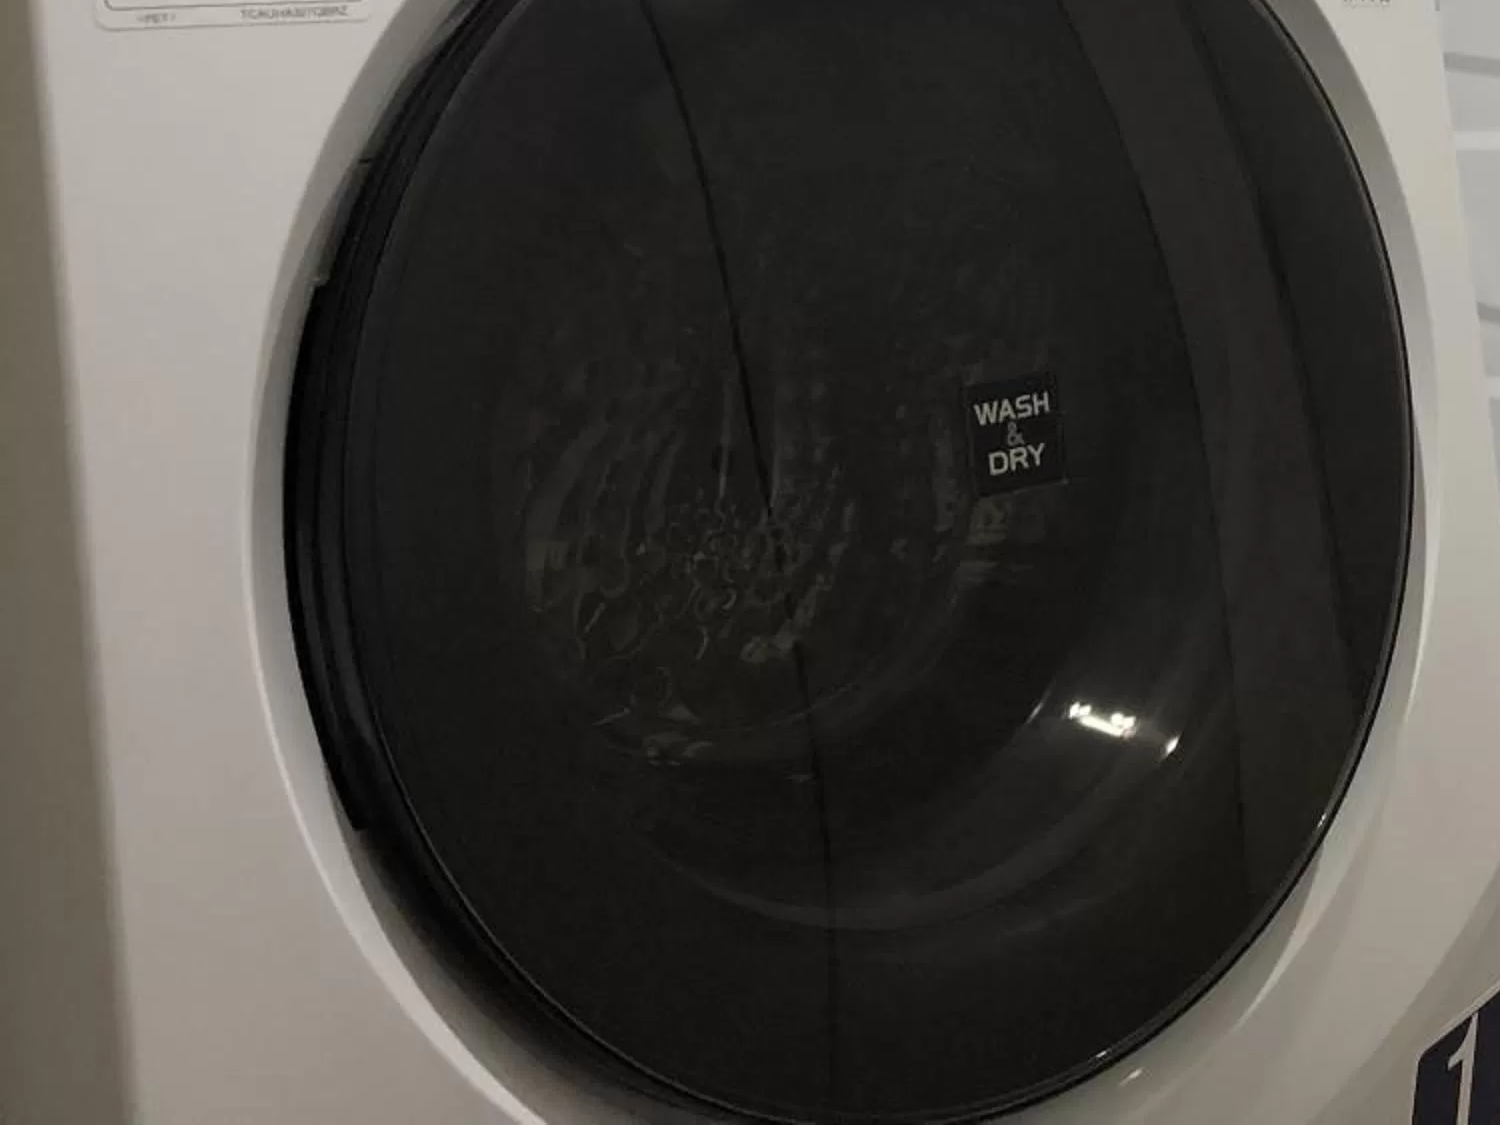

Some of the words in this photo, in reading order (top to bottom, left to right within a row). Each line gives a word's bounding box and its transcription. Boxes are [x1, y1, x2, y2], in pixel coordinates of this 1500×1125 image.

[973, 390, 1050, 426] WASH
[1006, 421, 1025, 446] &
[988, 442, 1046, 476] DRY
